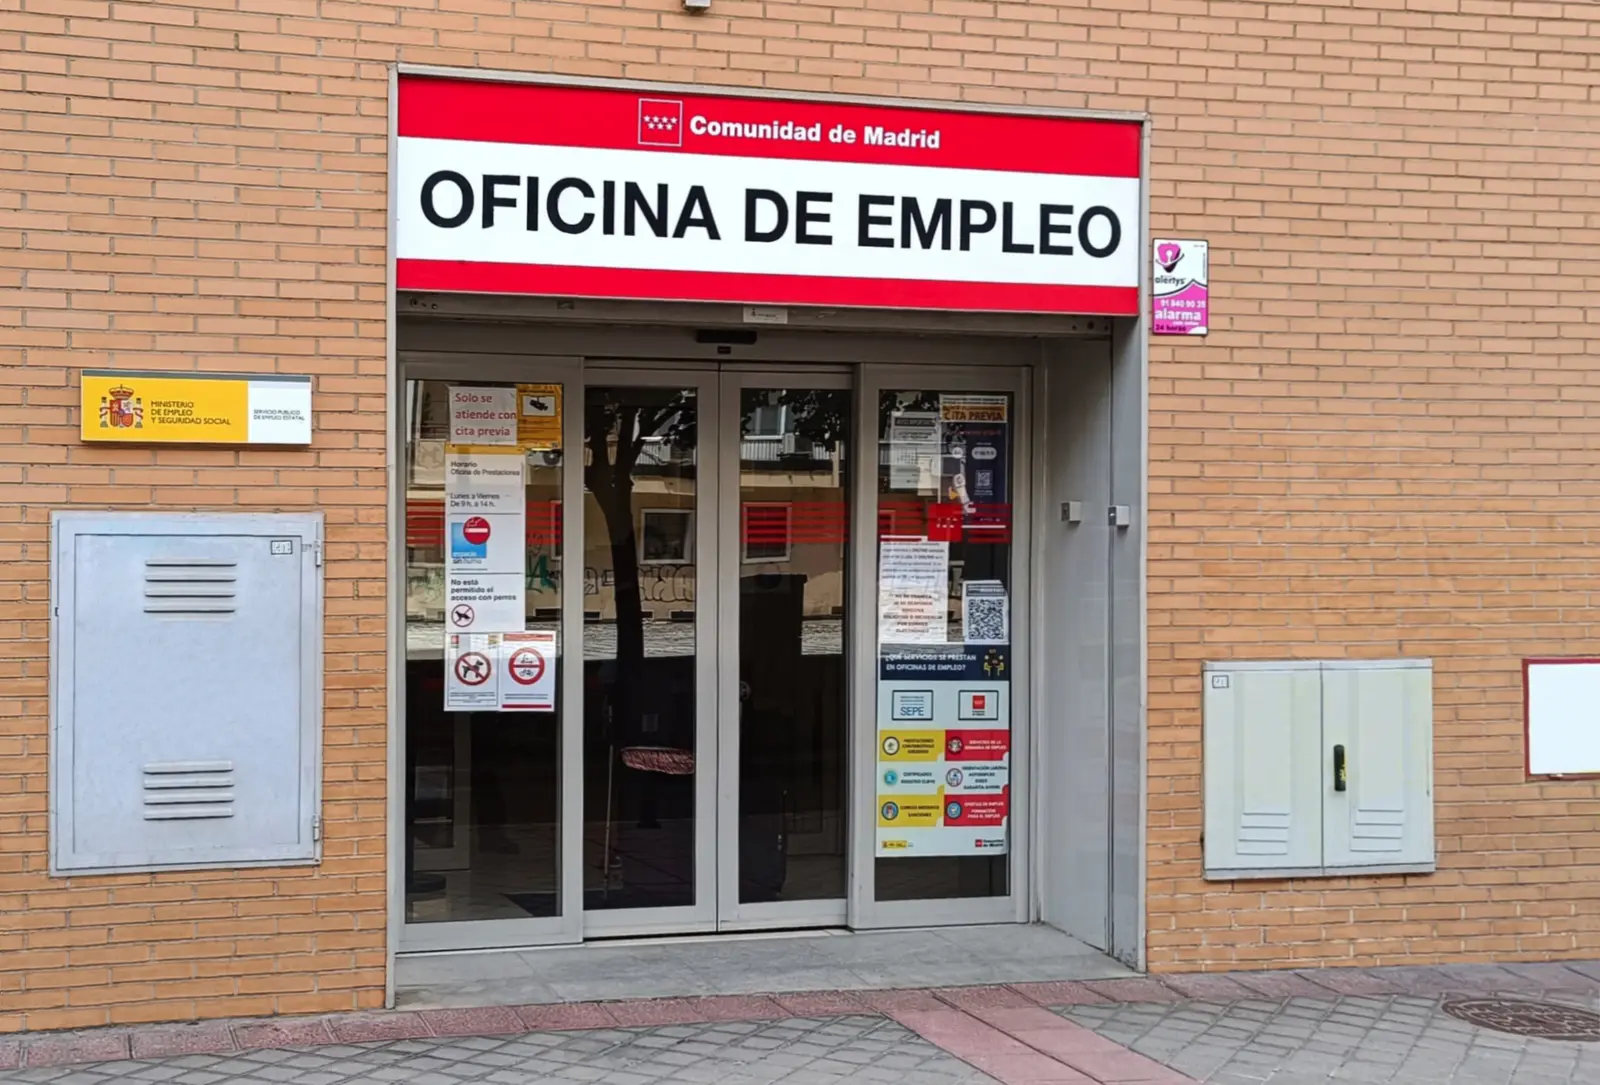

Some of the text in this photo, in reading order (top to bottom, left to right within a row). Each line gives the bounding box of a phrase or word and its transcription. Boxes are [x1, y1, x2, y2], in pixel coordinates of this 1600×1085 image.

[689, 114, 941, 150] Comunidad de Madrid
[420, 169, 1123, 260] OFICINA DE EMPLEO
[1154, 308, 1202, 321] alarma
[455, 392, 492, 403] Solo se
[151, 400, 194, 409] MINISTERIO
[151, 408, 162, 416] DE
[455, 409, 516, 420] atiende con
[968, 411, 1003, 421] PREVIA
[158, 417, 202, 425] SEGURIDAD
[203, 417, 231, 426] SOCIAL
[455, 427, 510, 438] cita previa
[463, 578, 479, 586] está
[451, 586, 485, 595] permitido
[493, 594, 517, 602] perros
[886, 663, 896, 671] EN
[900, 706, 925, 717] SEPE
